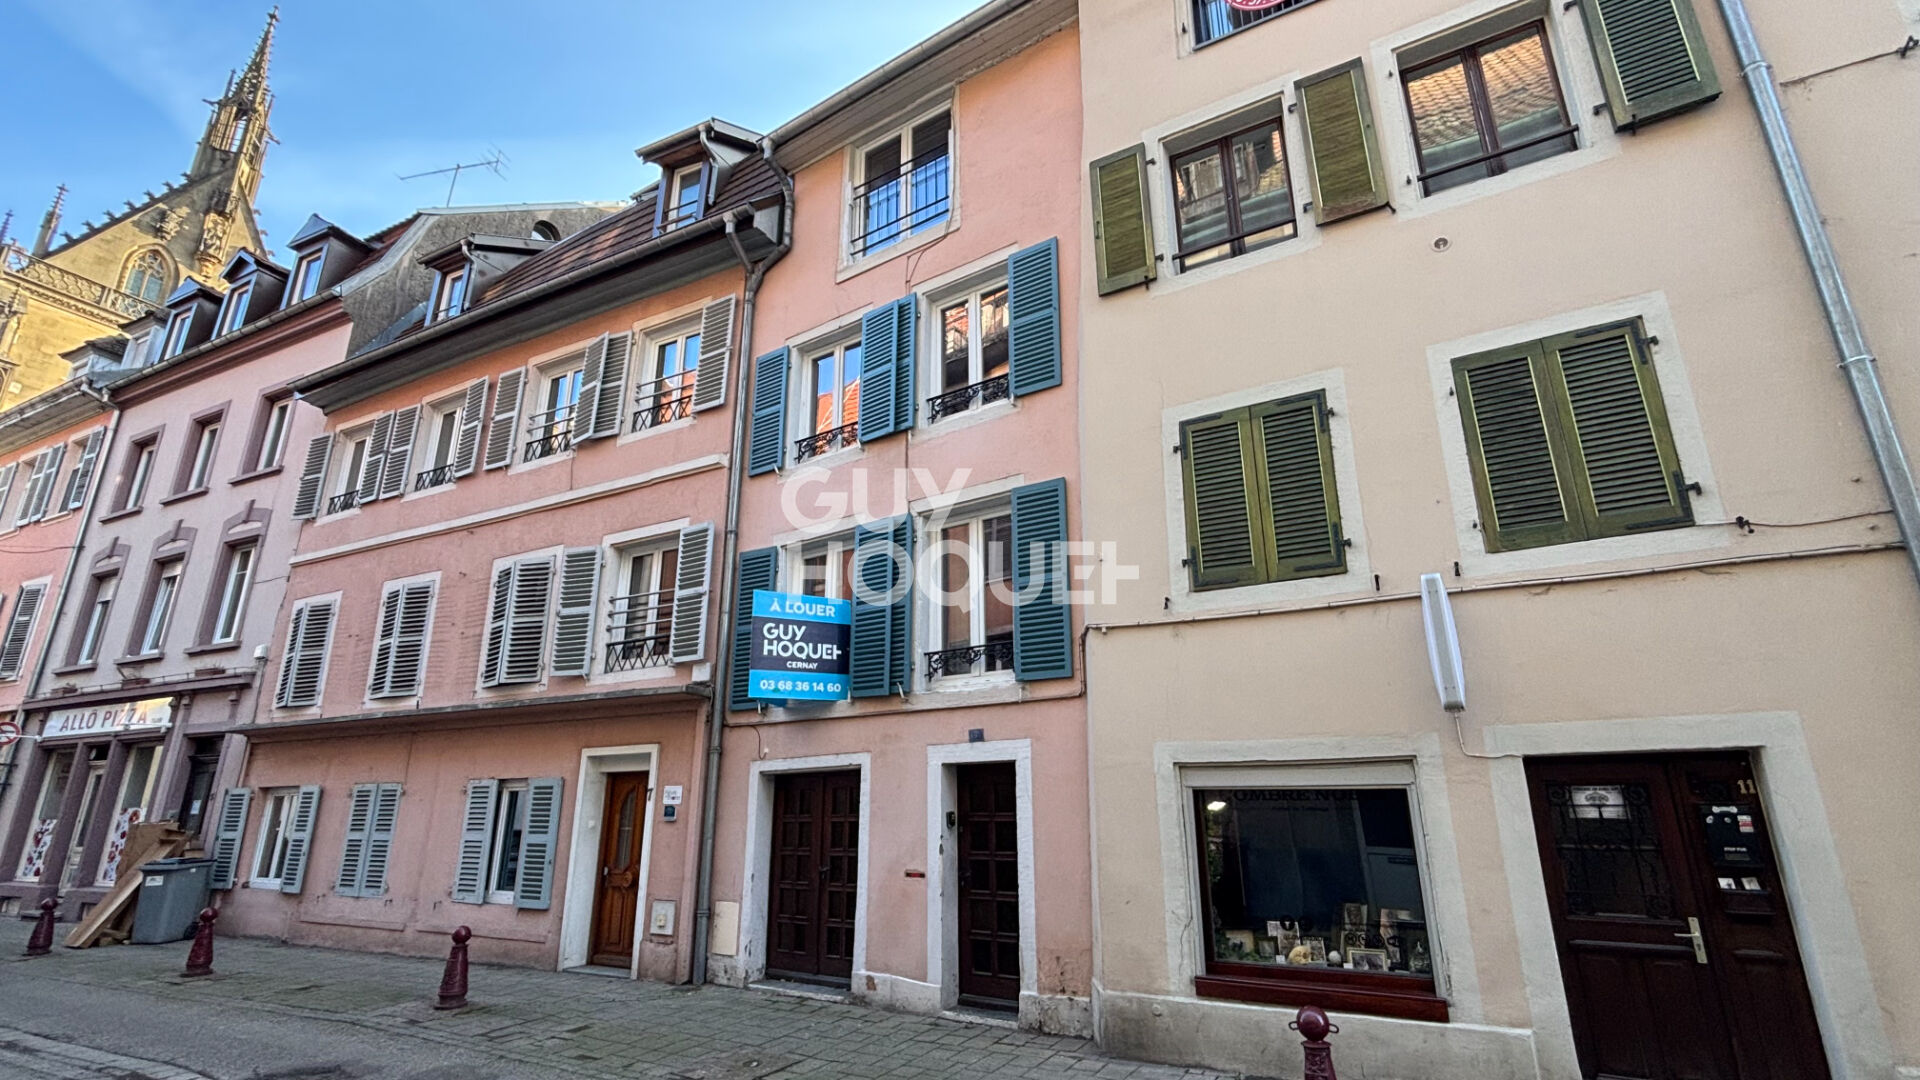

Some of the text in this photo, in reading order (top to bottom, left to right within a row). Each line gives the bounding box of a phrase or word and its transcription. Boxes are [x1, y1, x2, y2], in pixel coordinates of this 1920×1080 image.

[770, 598, 835, 617] À LOUER
[763, 622, 807, 641] GUY
[786, 660, 818, 670] CERNAY
[760, 679, 842, 693] 03 68 36 14 60
[1737, 779, 1756, 794] 11
[647, 787, 654, 801] 7
